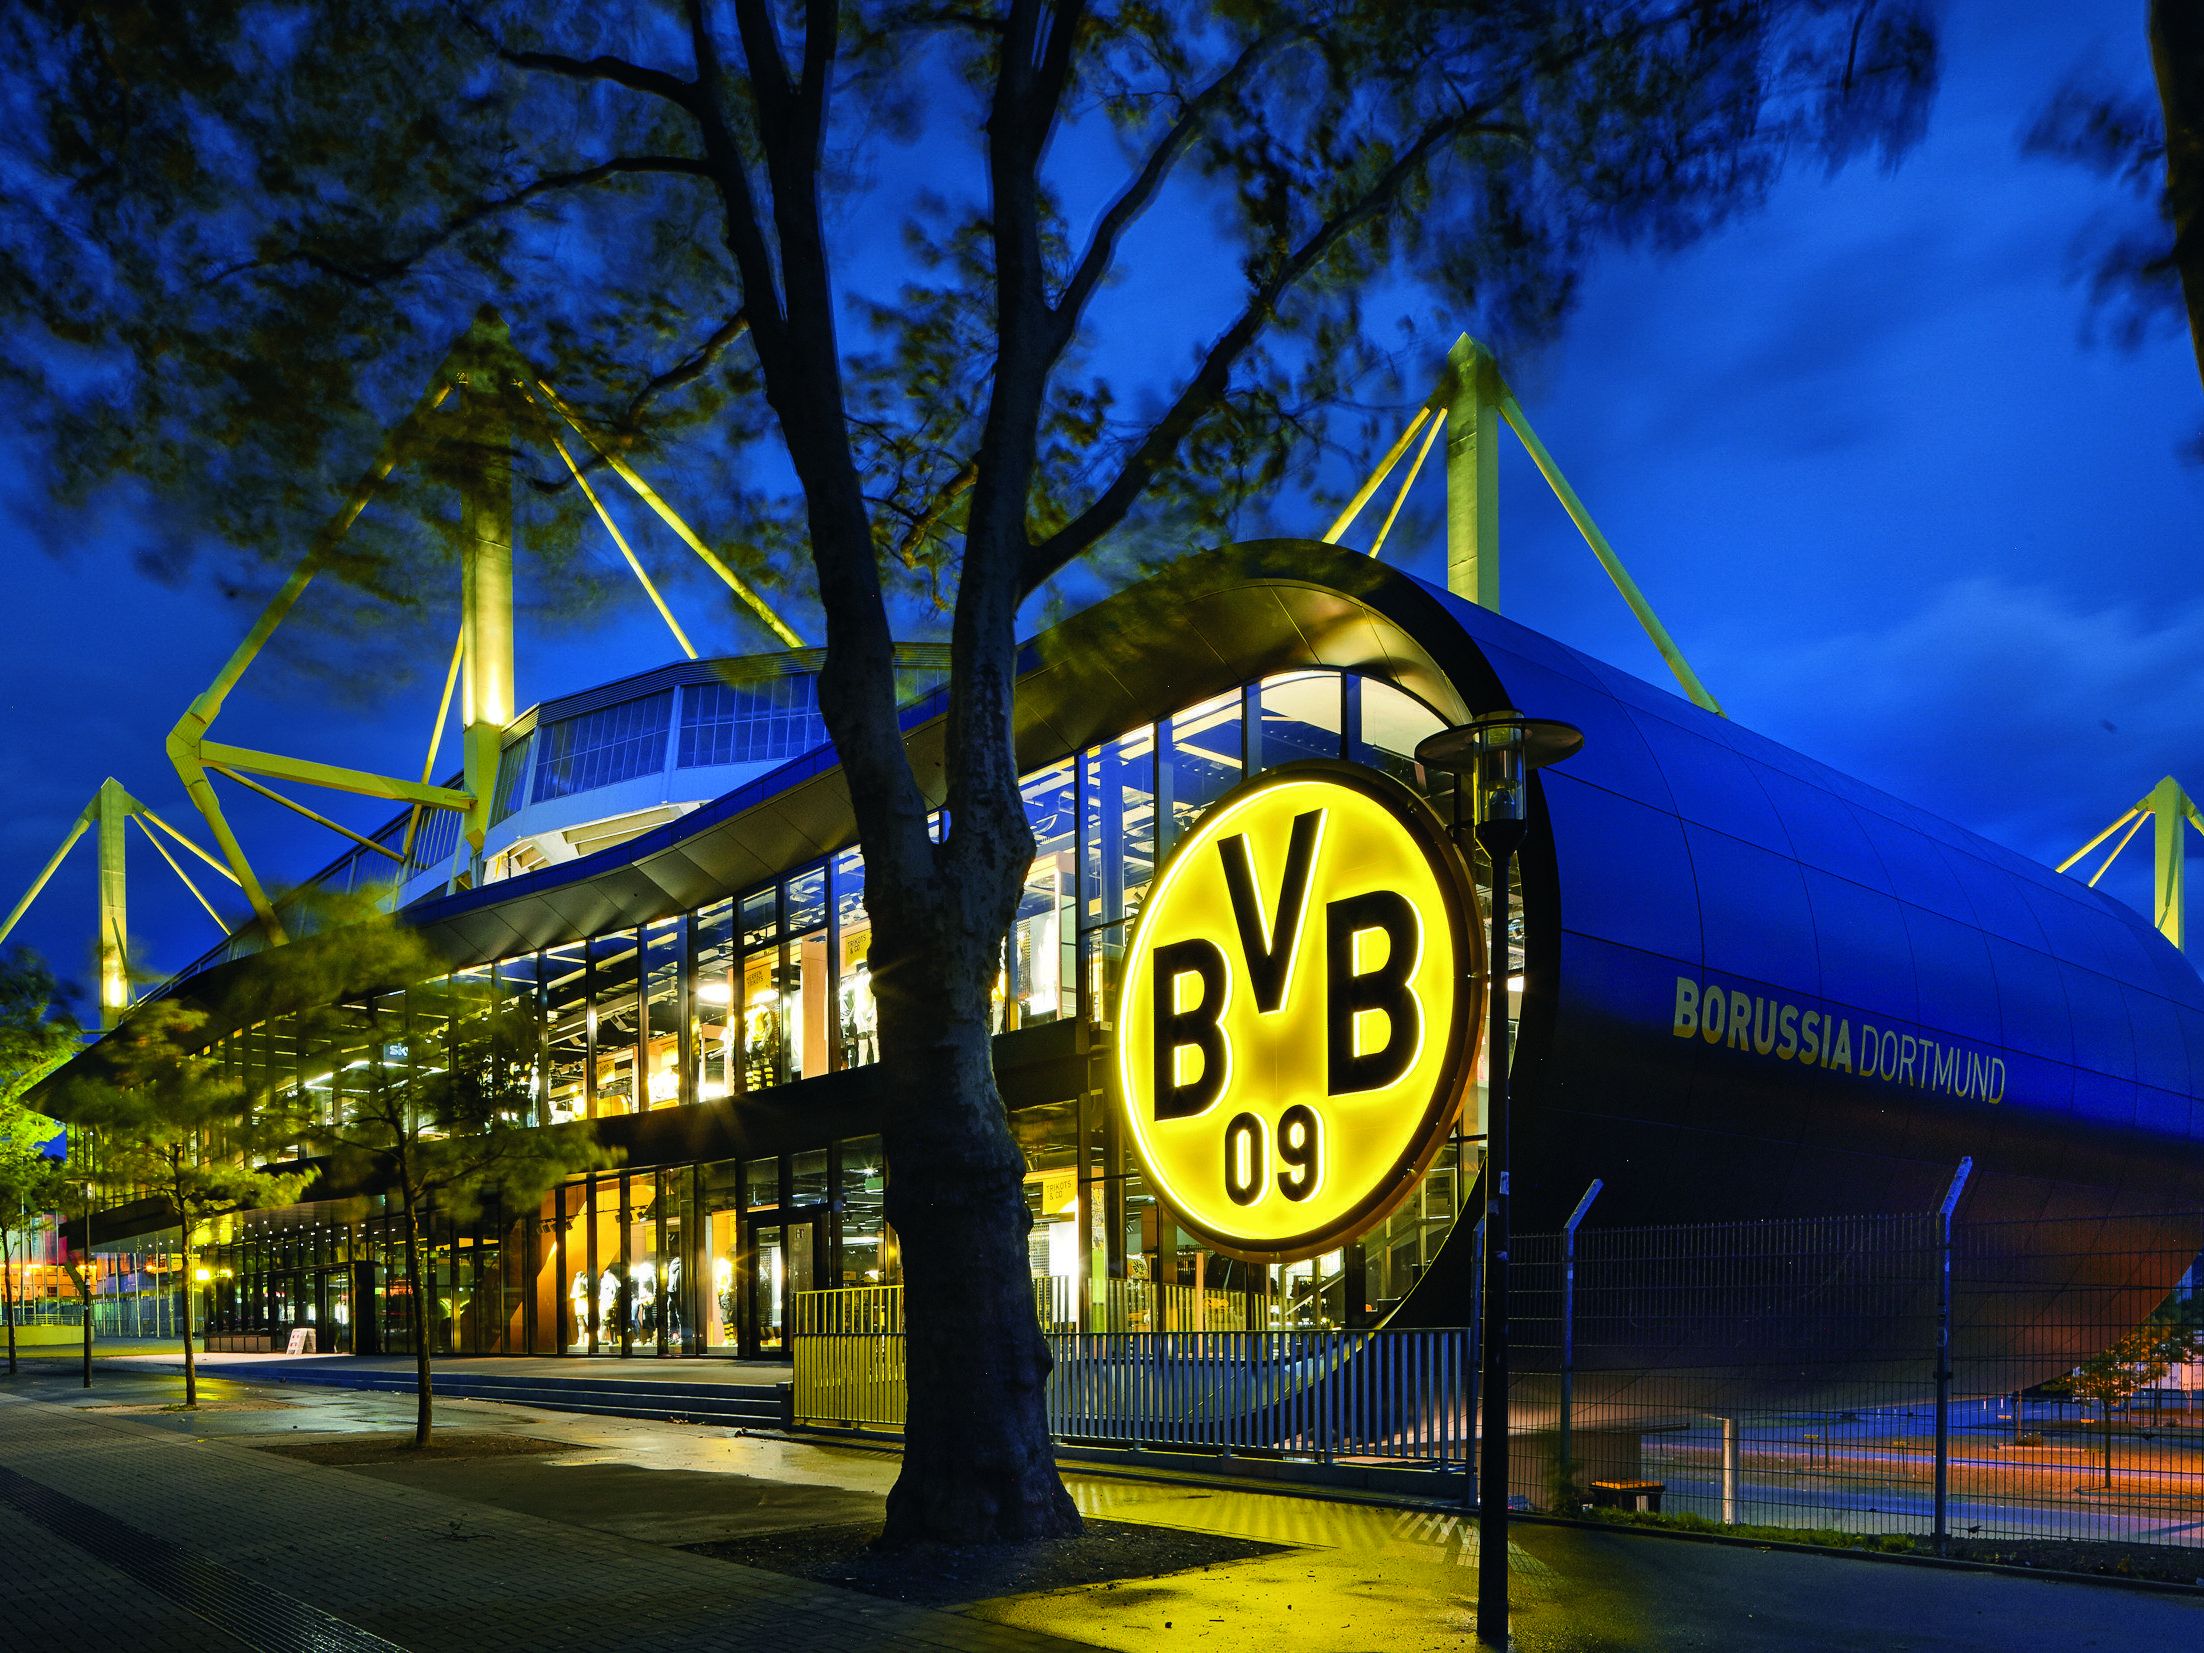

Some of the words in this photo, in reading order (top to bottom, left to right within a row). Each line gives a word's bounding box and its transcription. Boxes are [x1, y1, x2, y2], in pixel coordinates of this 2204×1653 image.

[1152, 807, 1425, 1122] BVB
[389, 1042, 409, 1057] sk
[1672, 976, 1852, 1074] BORUSSIA
[1858, 1024, 2006, 1105] DORTMUND
[1046, 1180, 1072, 1193] TRIKOTS
[1224, 1104, 1325, 1206] 09
